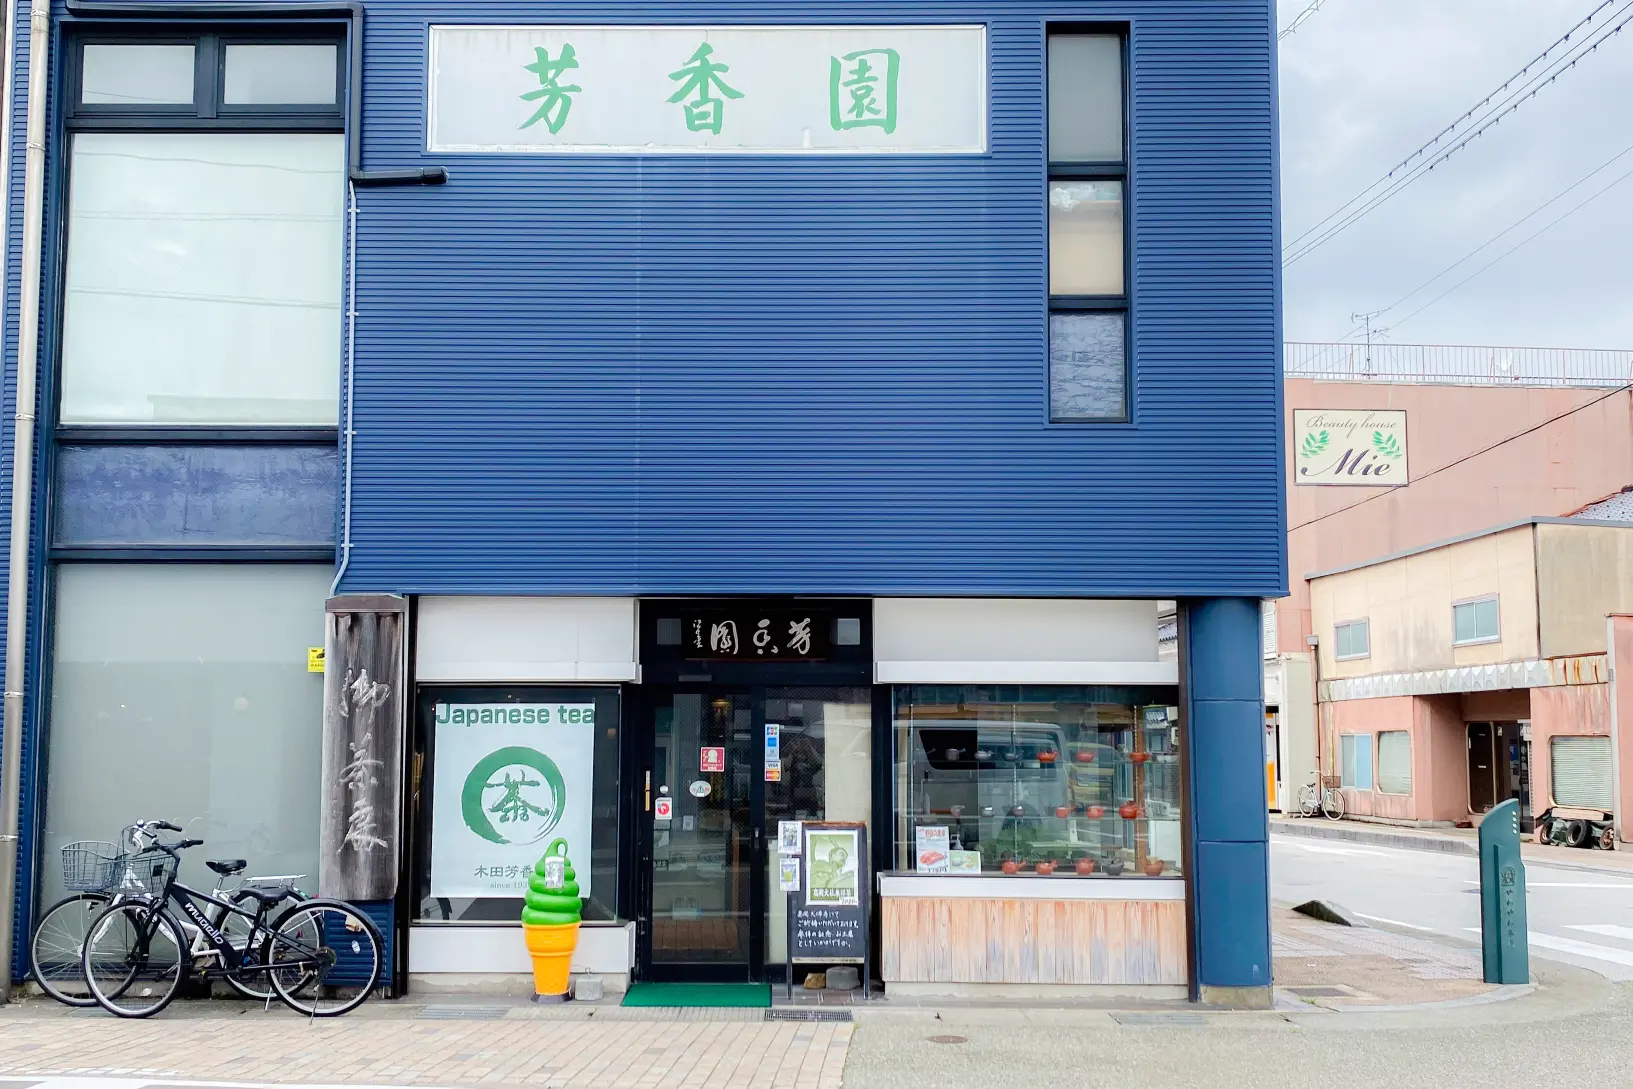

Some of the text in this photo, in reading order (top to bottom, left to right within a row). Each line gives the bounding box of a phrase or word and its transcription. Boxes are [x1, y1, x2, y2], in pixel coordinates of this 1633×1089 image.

[517, 42, 900, 136] 芳香園
[1305, 412, 1397, 439] Beauty house
[1300, 448, 1392, 477] Mie
[435, 703, 595, 727] Japanese tea
[484, 769, 551, 823] 茶
[474, 864, 534, 879] 木田芳香
[490, 881, 511, 889] since
[184, 902, 224, 944] mugello
